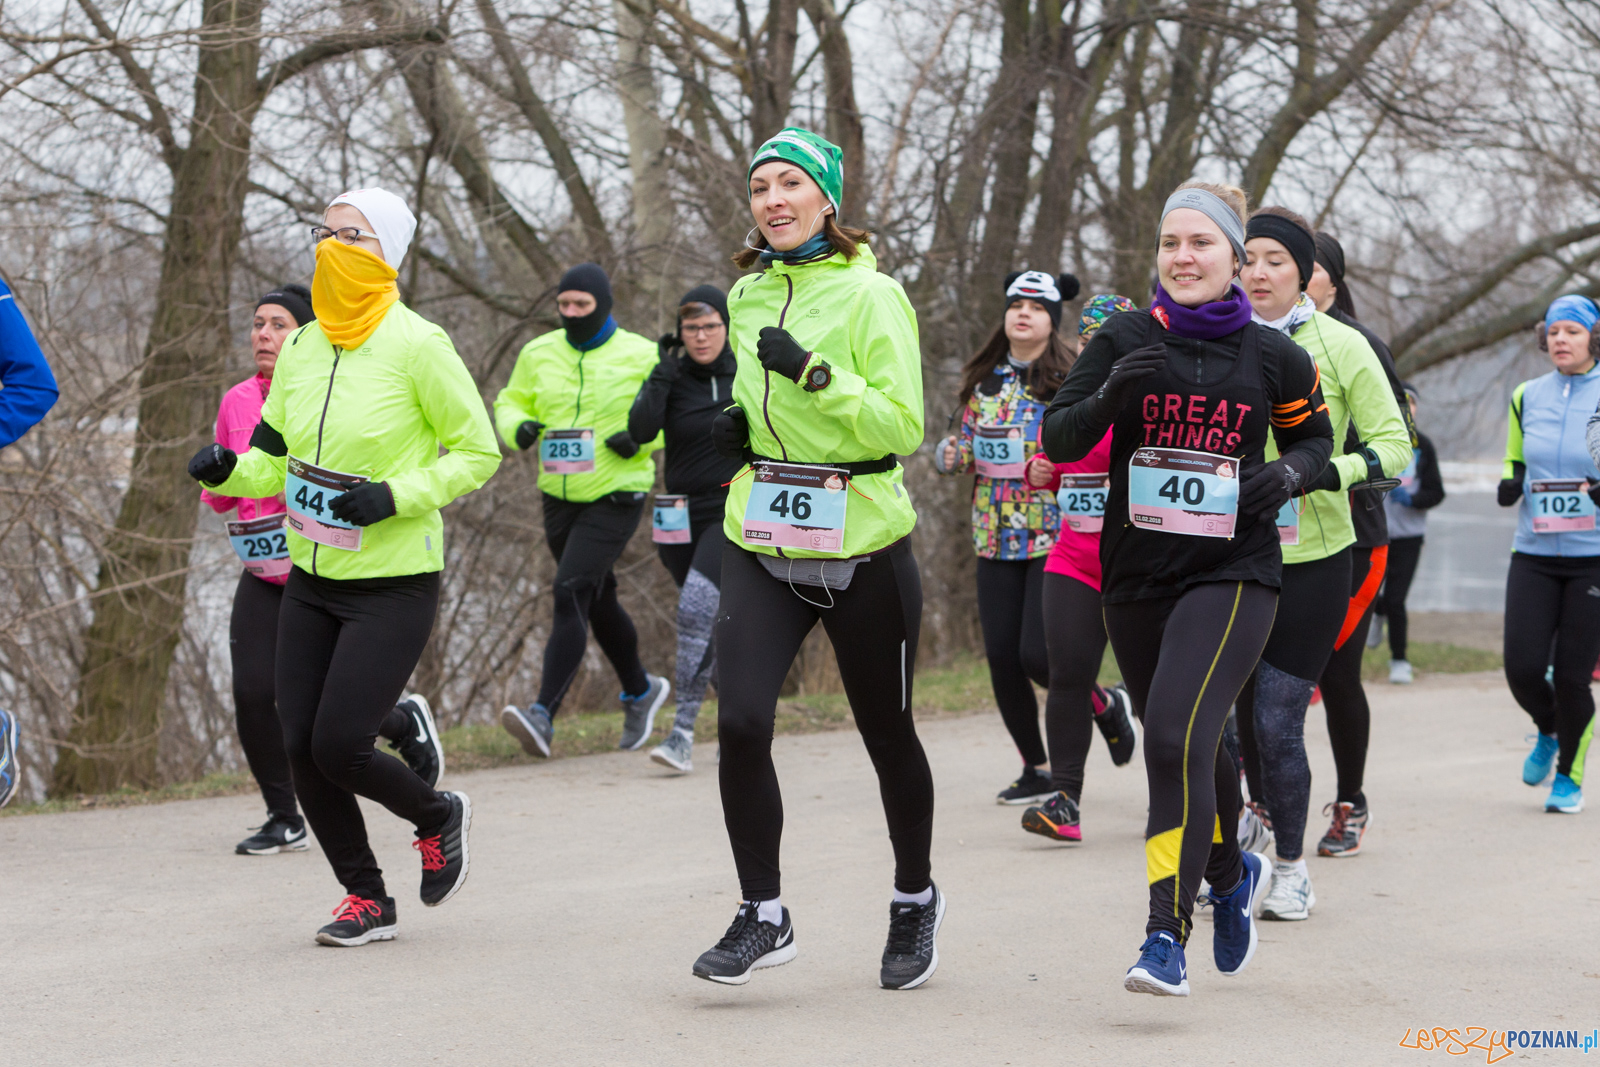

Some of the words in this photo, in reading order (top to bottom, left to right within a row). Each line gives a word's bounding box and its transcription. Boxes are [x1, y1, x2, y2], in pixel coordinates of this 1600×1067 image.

[1142, 393, 1252, 431] GREAT
[549, 442, 582, 458] 283
[979, 440, 1010, 460] 333
[1143, 422, 1242, 454] THINGS
[1067, 492, 1106, 512] 253
[1158, 475, 1205, 506] 40
[769, 489, 812, 520] 46
[1539, 496, 1581, 513] 102
[243, 533, 288, 557] 292
